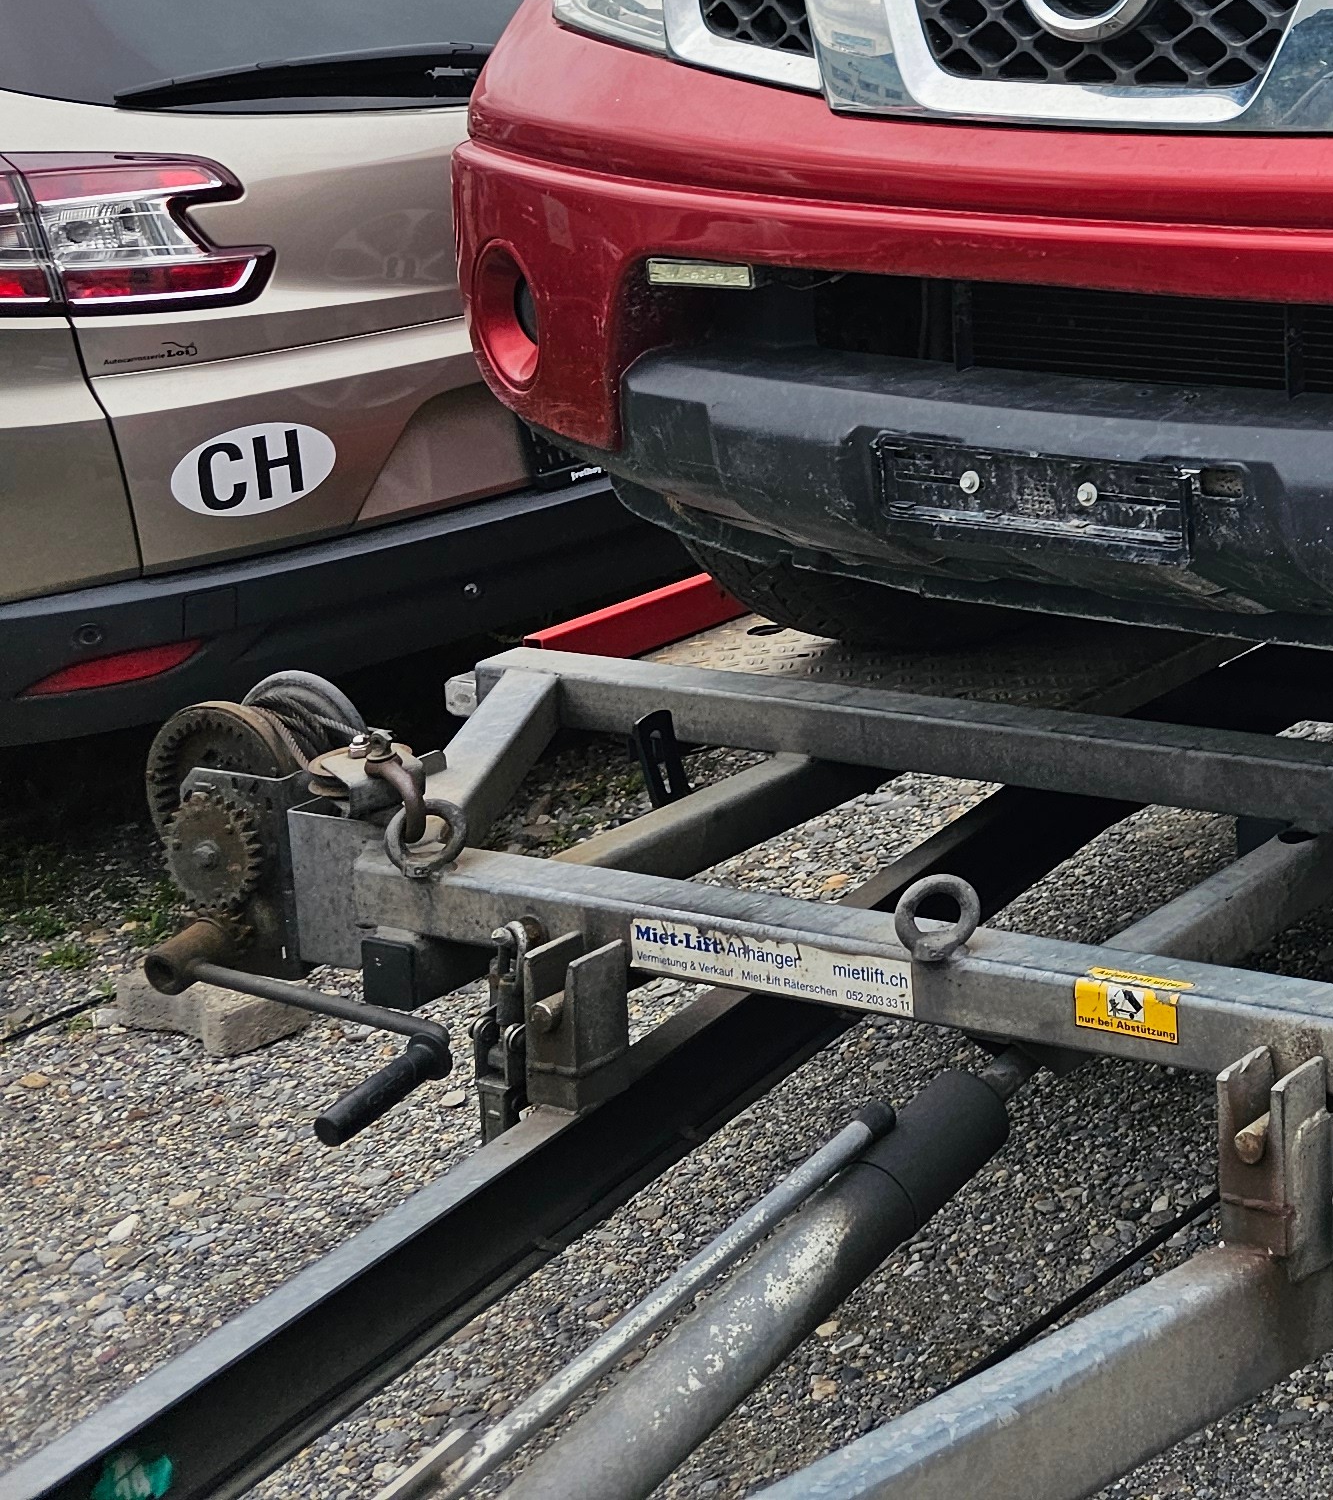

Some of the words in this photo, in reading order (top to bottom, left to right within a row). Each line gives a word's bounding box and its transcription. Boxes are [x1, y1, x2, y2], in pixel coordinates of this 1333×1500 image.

[197, 428, 305, 511] CH
[636, 950, 688, 971] Vermietung
[689, 960, 697, 971] &
[698, 962, 734, 978] Verkauf
[846, 989, 864, 1003] 052
[866, 993, 884, 1007] 203
[885, 997, 898, 1009] 33
[832, 963, 909, 989] mietlift.ch
[1078, 1015, 1096, 1025] nur
[1097, 1017, 1114, 1028] bei
[1116, 1020, 1176, 1041] Abstützung
